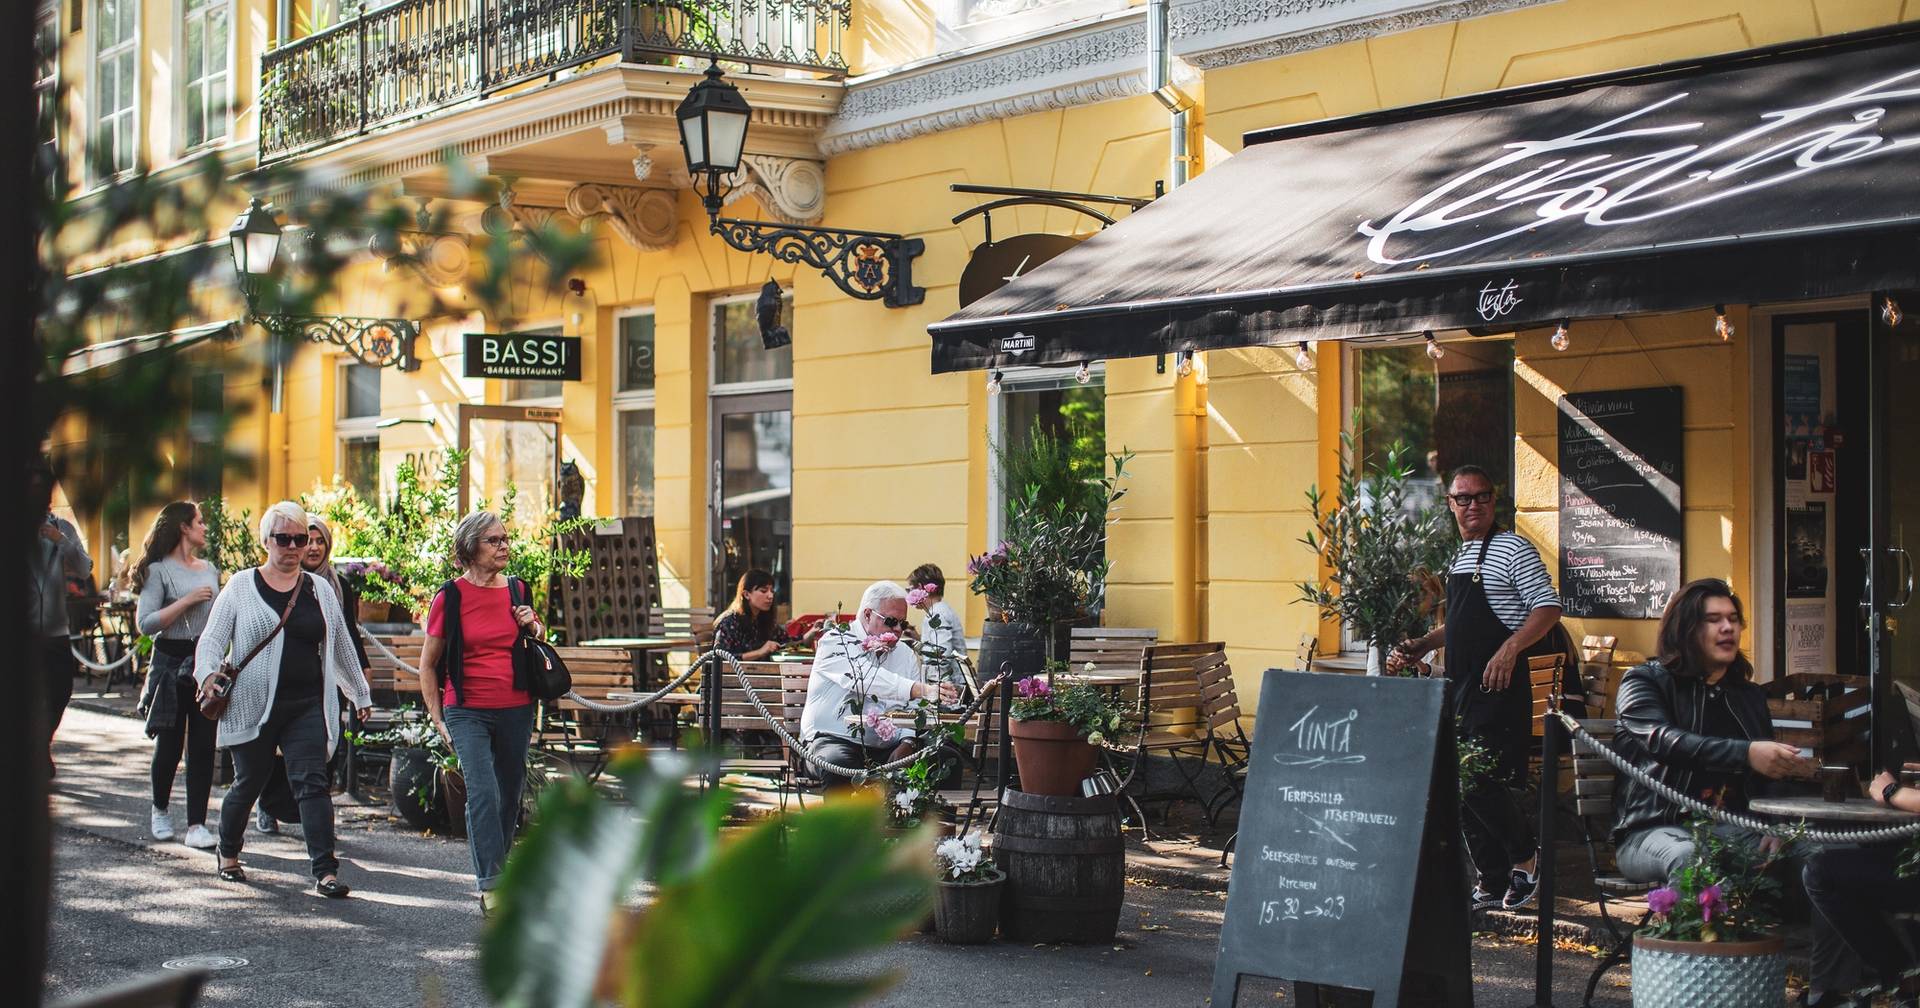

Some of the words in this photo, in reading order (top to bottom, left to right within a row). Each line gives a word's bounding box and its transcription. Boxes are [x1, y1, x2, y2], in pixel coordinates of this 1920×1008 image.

[483, 338, 566, 365] BASSI
[1003, 338, 1033, 349] MARTINI
[1322, 896, 1345, 920] 23
